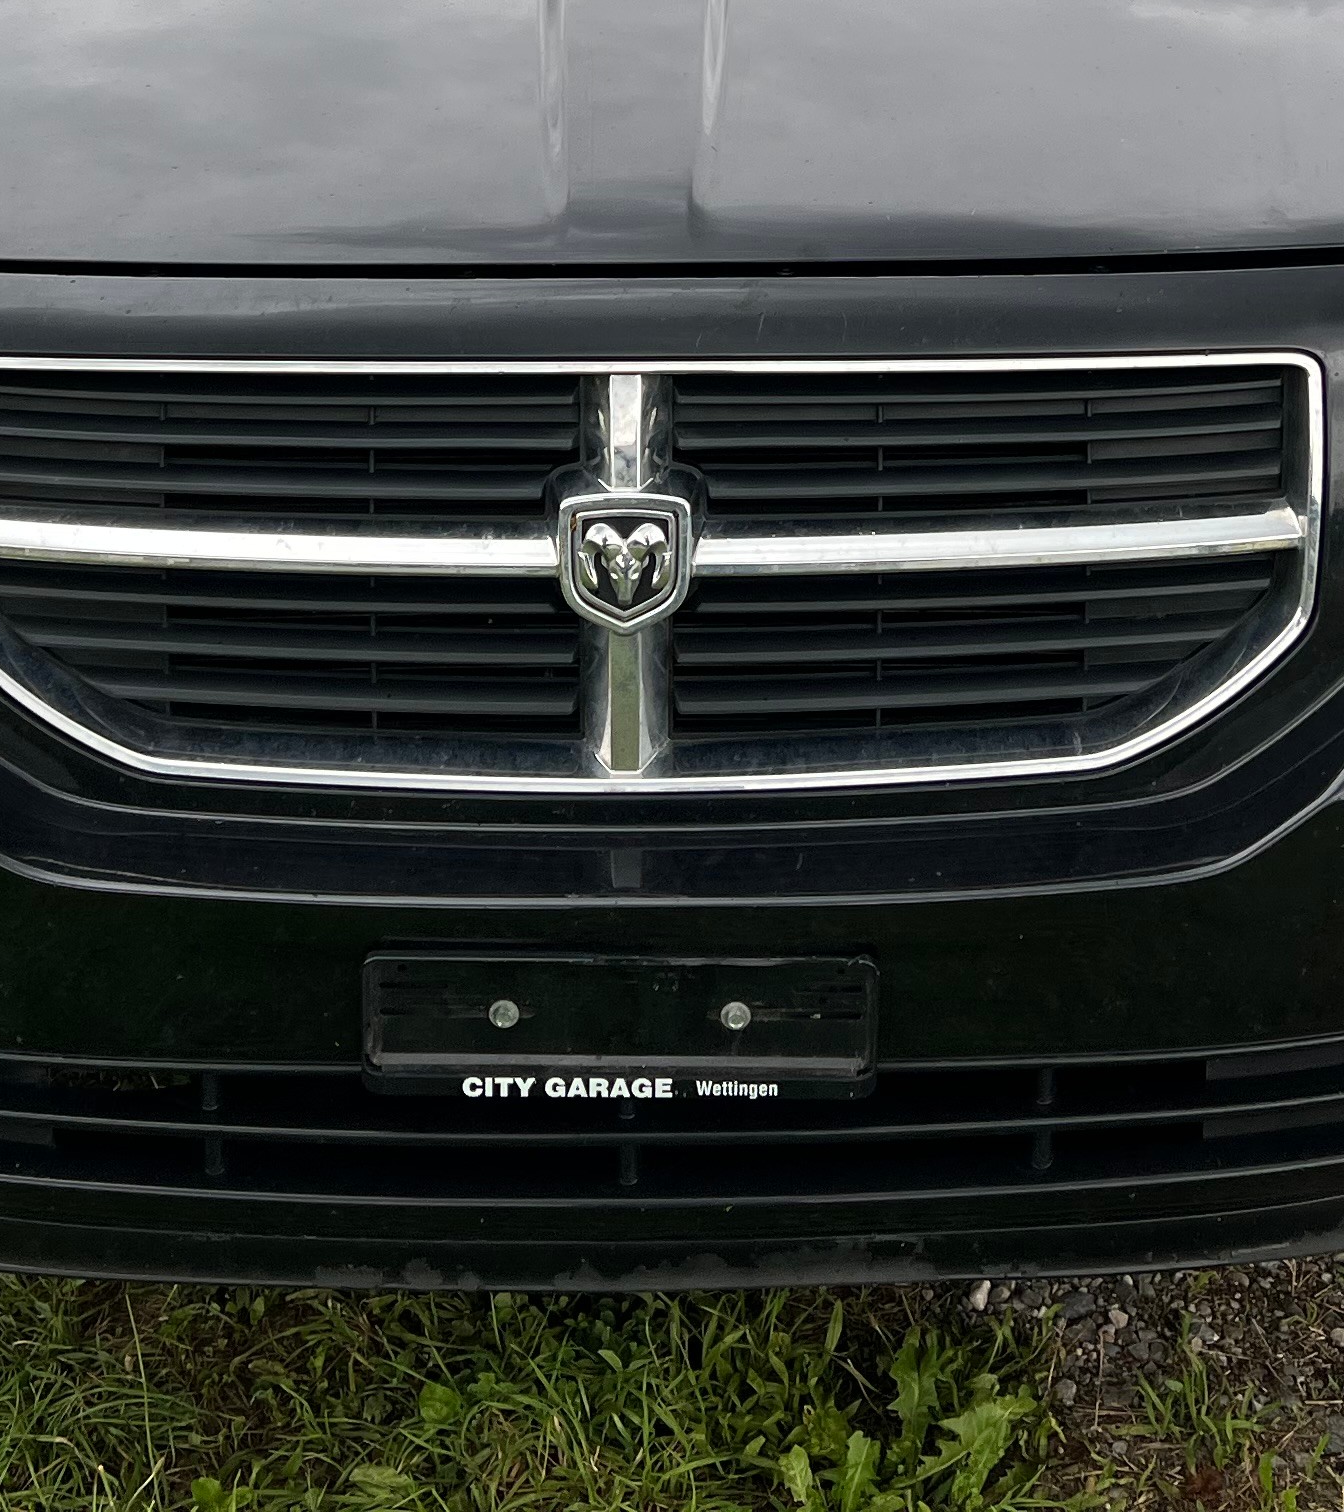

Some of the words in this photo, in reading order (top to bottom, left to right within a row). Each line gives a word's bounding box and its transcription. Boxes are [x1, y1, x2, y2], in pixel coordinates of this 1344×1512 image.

[462, 1077, 536, 1098] CITY
[544, 1077, 673, 1098] GARAGE
[696, 1080, 779, 1099] Wettingen
